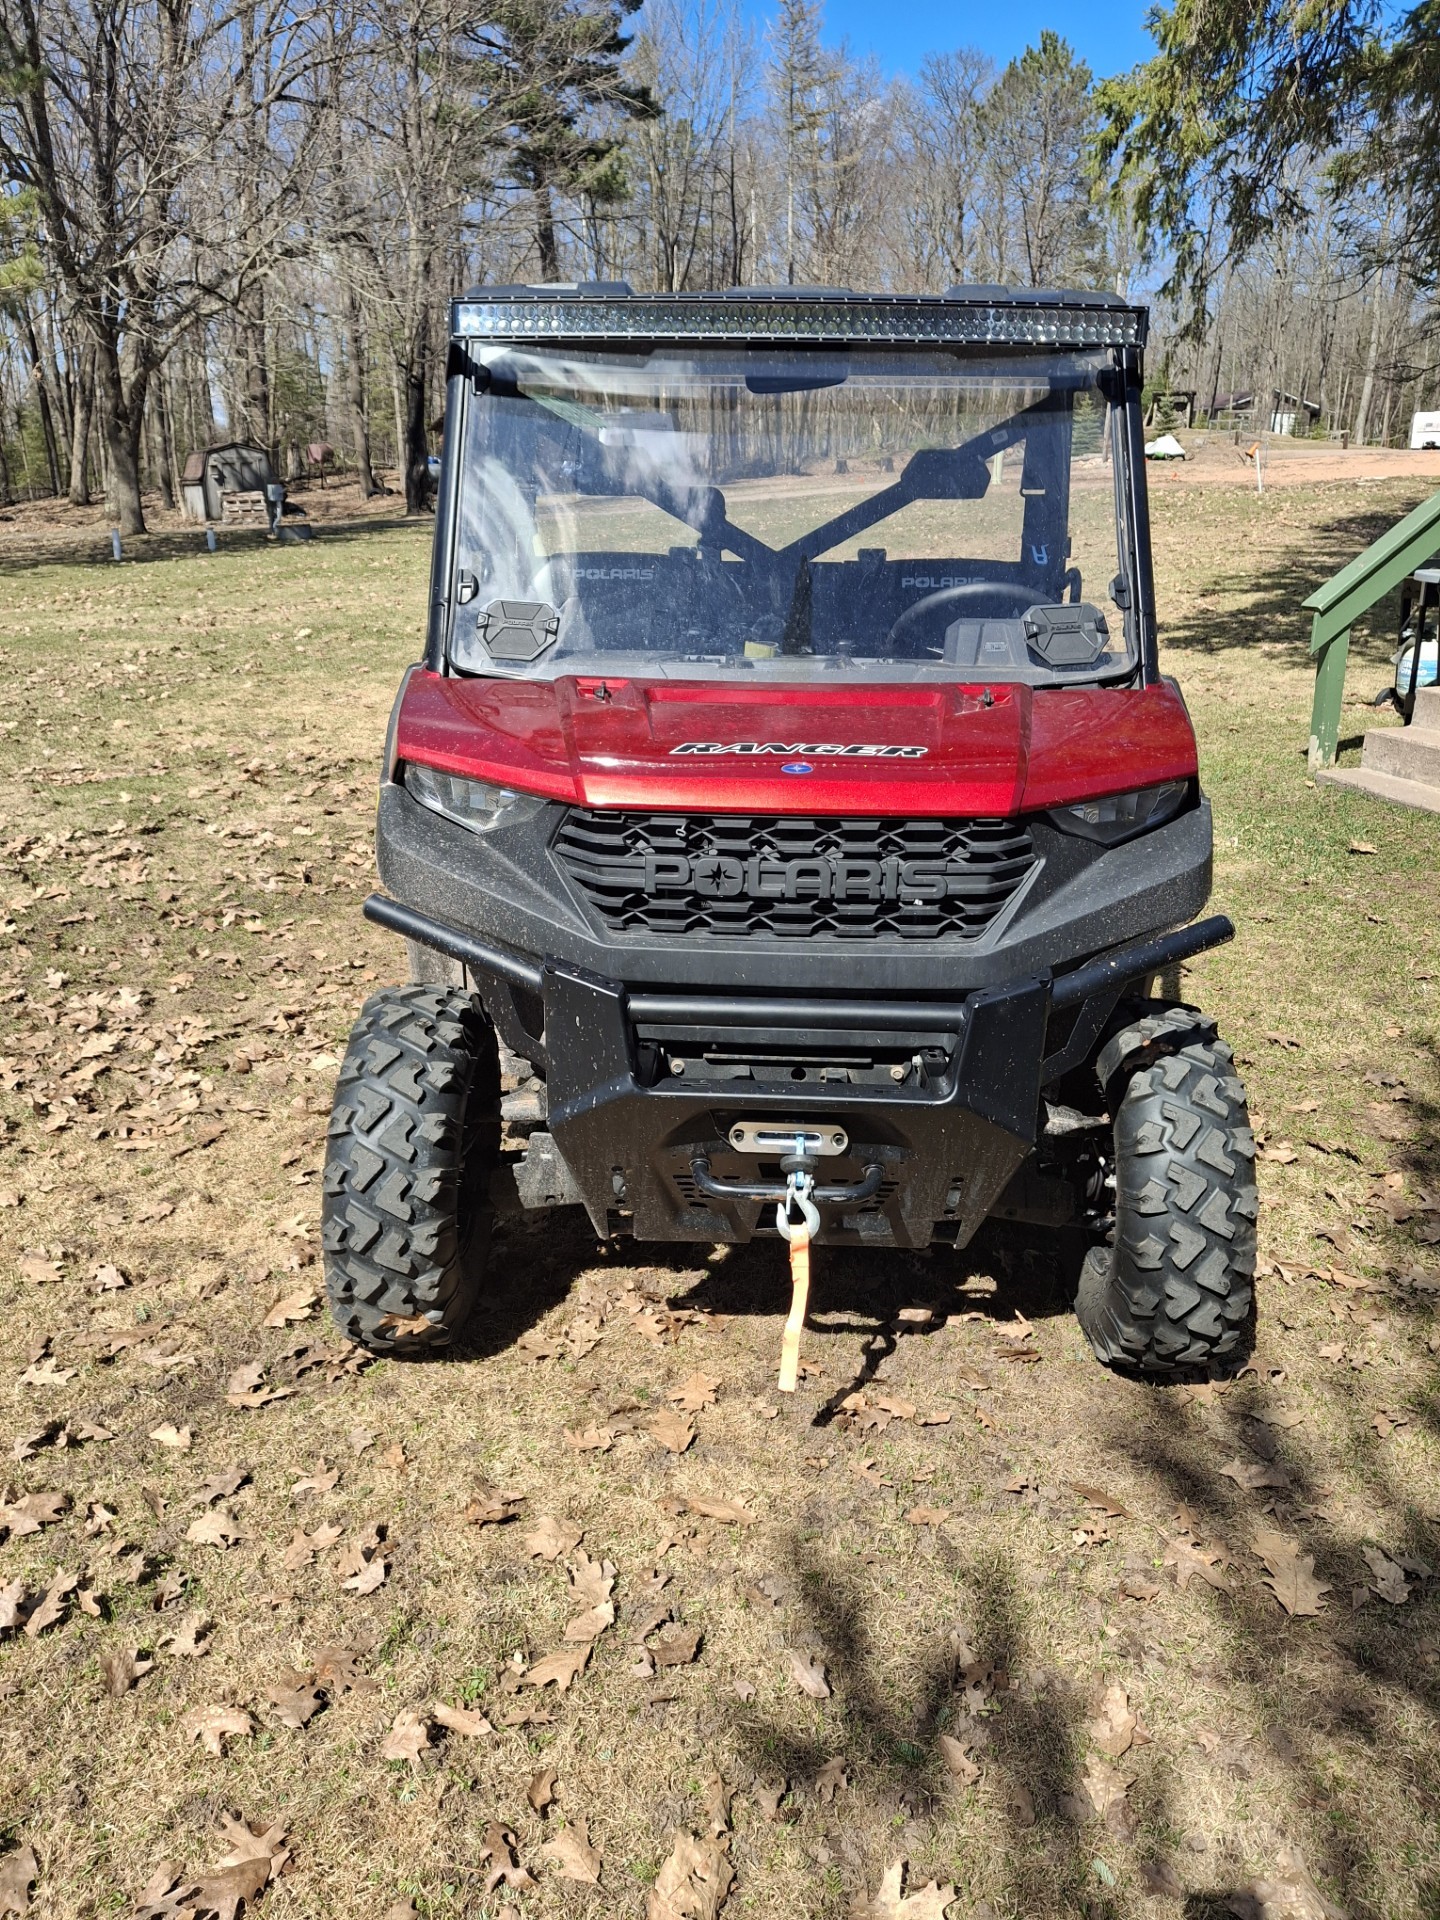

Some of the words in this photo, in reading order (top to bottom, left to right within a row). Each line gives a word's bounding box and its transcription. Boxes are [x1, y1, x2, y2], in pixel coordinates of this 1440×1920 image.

[573, 568, 654, 580] POLARIS
[669, 743, 929, 758] RANGER
[644, 853, 949, 900] POLARIS
